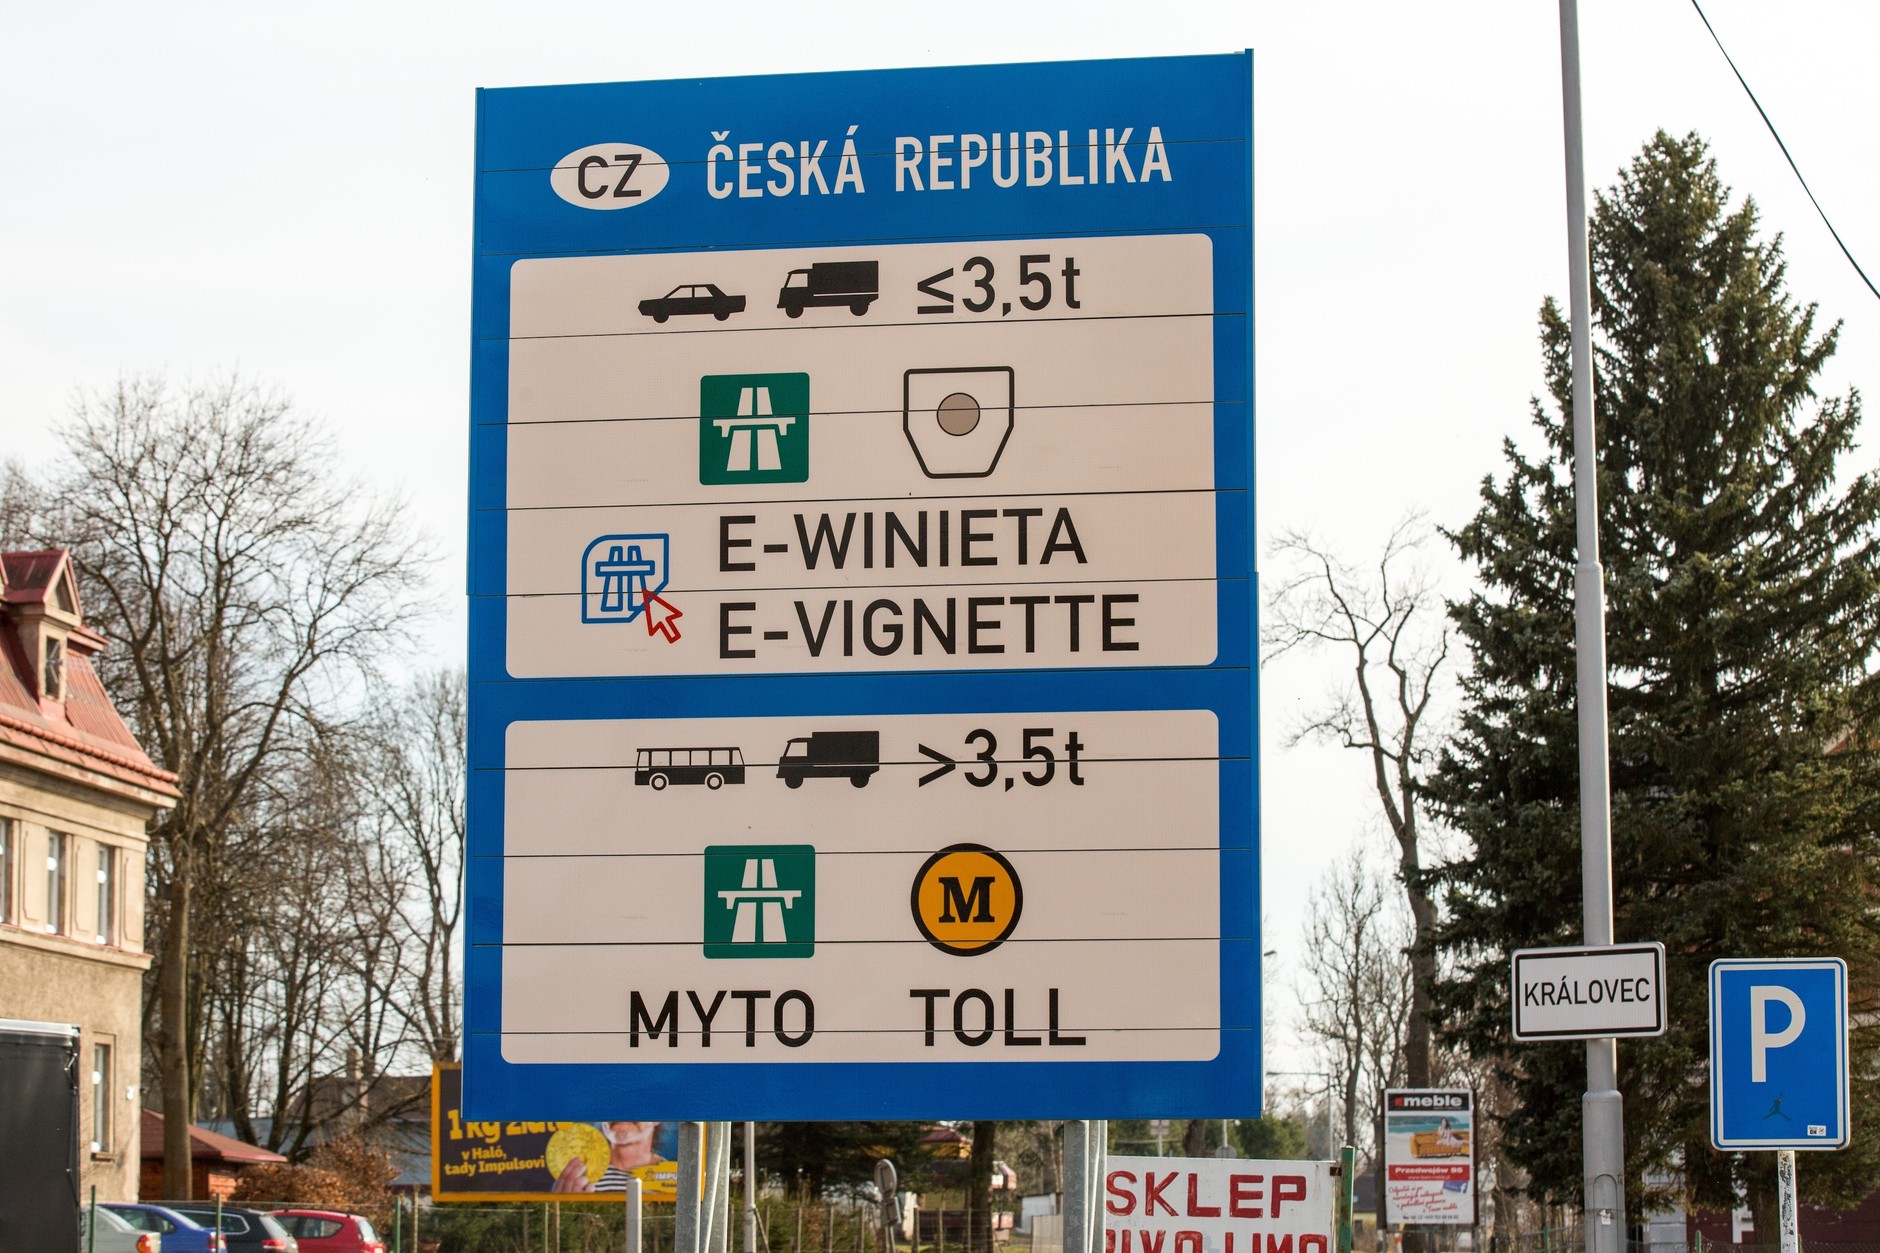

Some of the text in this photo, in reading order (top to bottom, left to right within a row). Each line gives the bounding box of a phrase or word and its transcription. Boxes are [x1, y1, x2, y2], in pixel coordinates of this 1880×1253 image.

[577, 125, 1172, 199] CZ ČESKÁ REPUBLIKA
[719, 507, 1088, 572] E-WINIETA
[719, 593, 1140, 659] E-VIGNETTE
[938, 875, 996, 924] M
[1524, 975, 1651, 1007] KRÁLOVEC
[629, 987, 1087, 1048] MYTO TOLL
[1750, 985, 1806, 1083] P
[1404, 1094, 1463, 1107] meble
[448, 1110, 463, 1140] 1
[444, 1155, 546, 1177] tady Impulsovi
[461, 1145, 507, 1162] v Haló,
[1106, 1170, 1307, 1218] SKLEP
